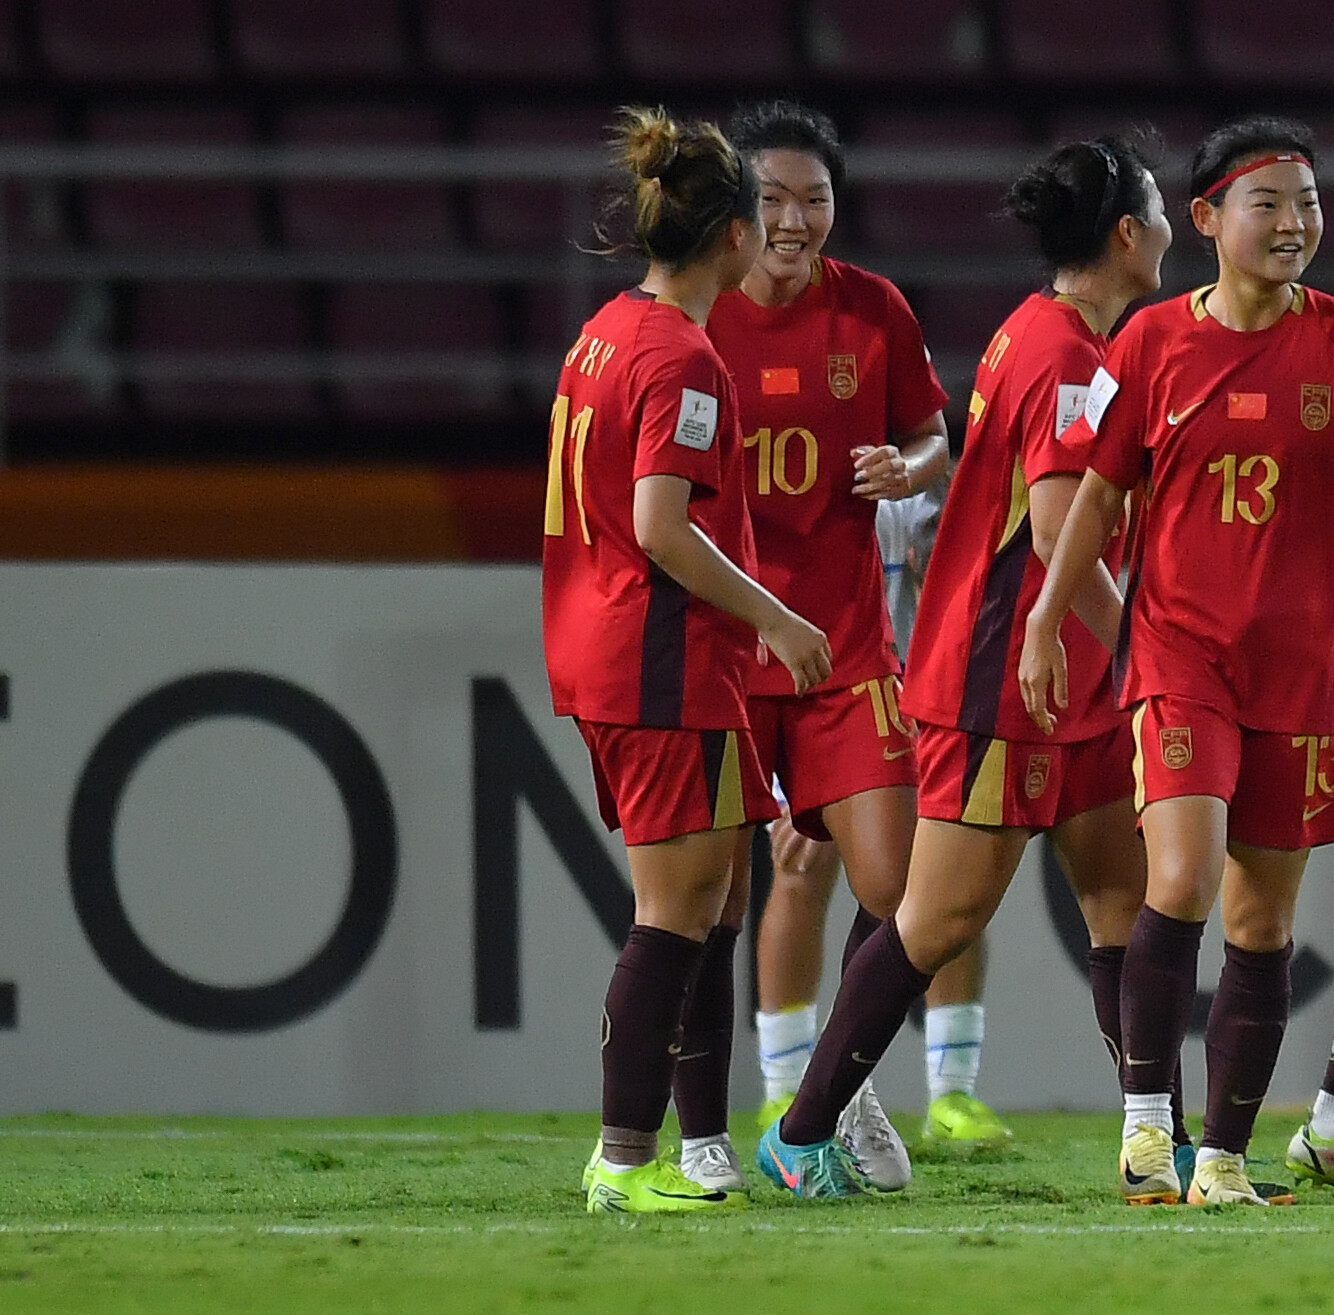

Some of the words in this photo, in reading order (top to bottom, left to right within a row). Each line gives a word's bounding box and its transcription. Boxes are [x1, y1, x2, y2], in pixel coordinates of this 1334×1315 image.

[544, 394, 594, 545] 11
[743, 427, 818, 495] 10
[1208, 454, 1279, 525] 13
[851, 674, 918, 737] 10
